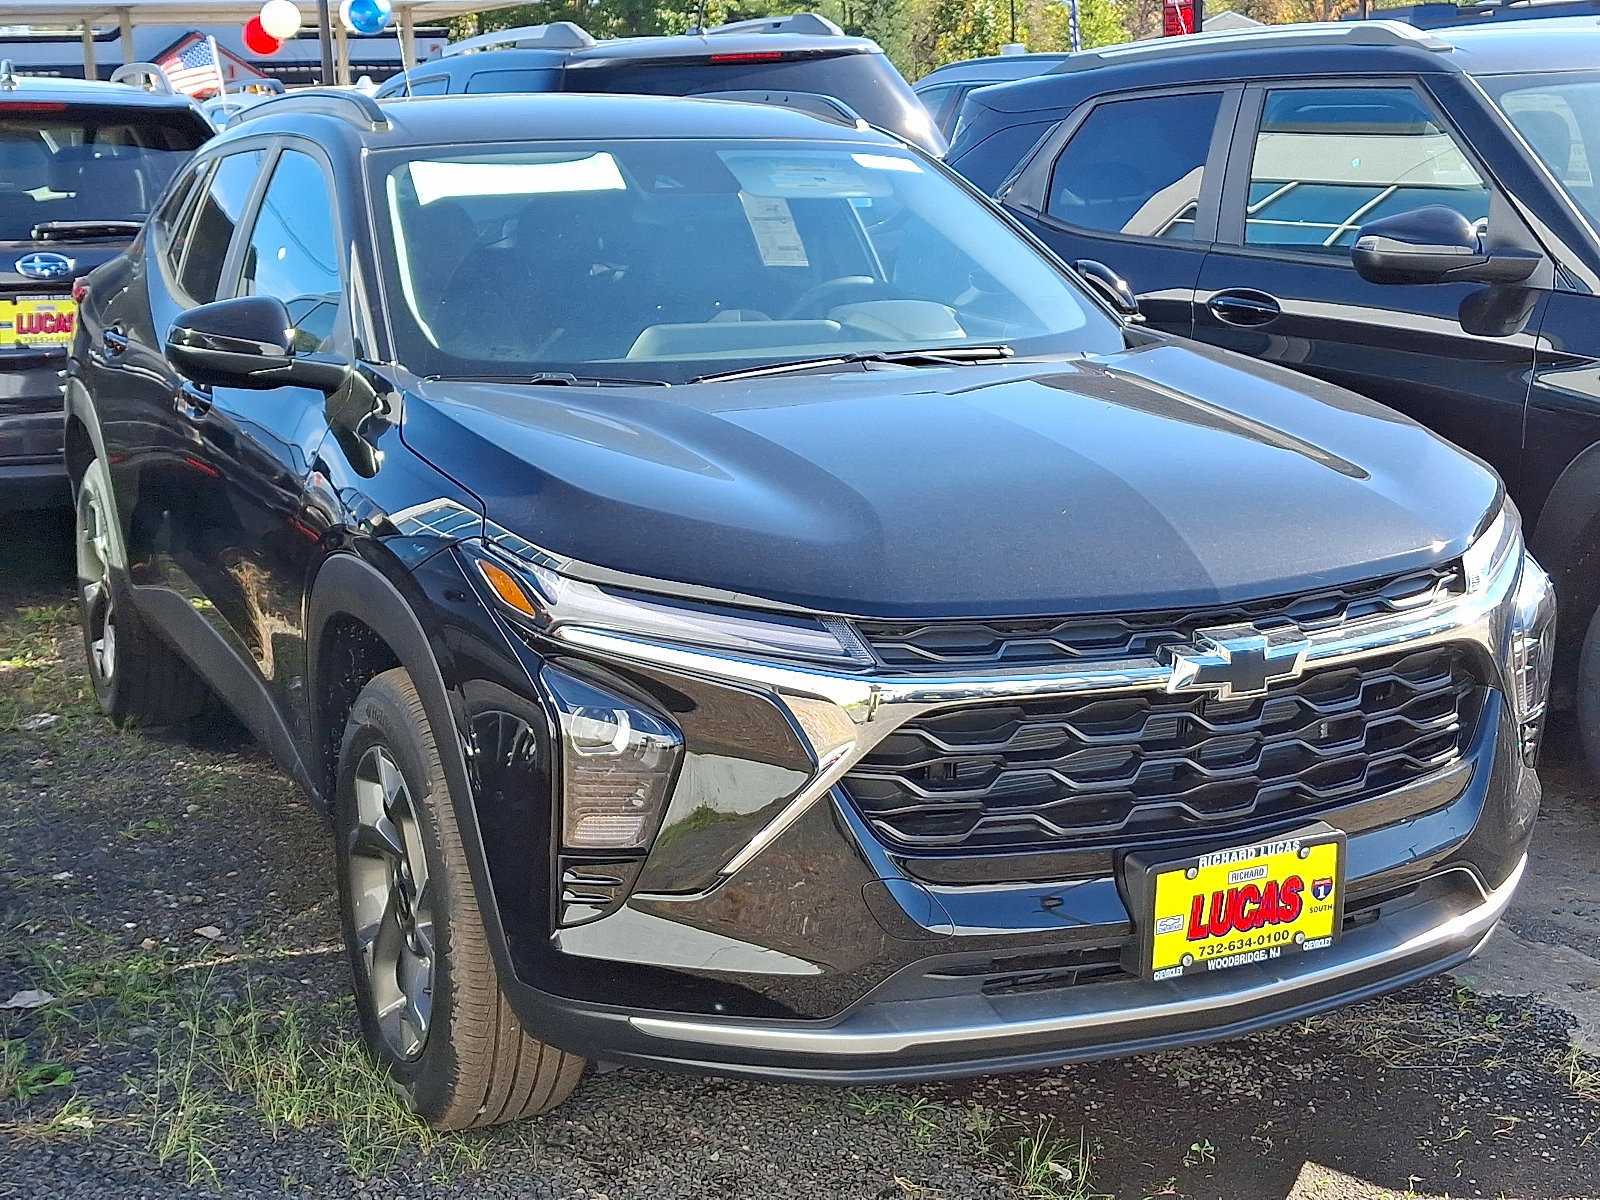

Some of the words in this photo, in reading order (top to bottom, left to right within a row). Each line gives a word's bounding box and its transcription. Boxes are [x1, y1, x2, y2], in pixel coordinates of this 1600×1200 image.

[1198, 848, 1256, 867] RICHARD
[1260, 840, 1301, 857] LUCAS
[1231, 867, 1265, 882] RICHARD
[1317, 885, 1326, 899] 1
[1186, 875, 1304, 941] LUCAS
[1309, 904, 1333, 914] SOUTH
[1198, 930, 1290, 957] 732-634-0100
[1269, 947, 1281, 959] NJ
